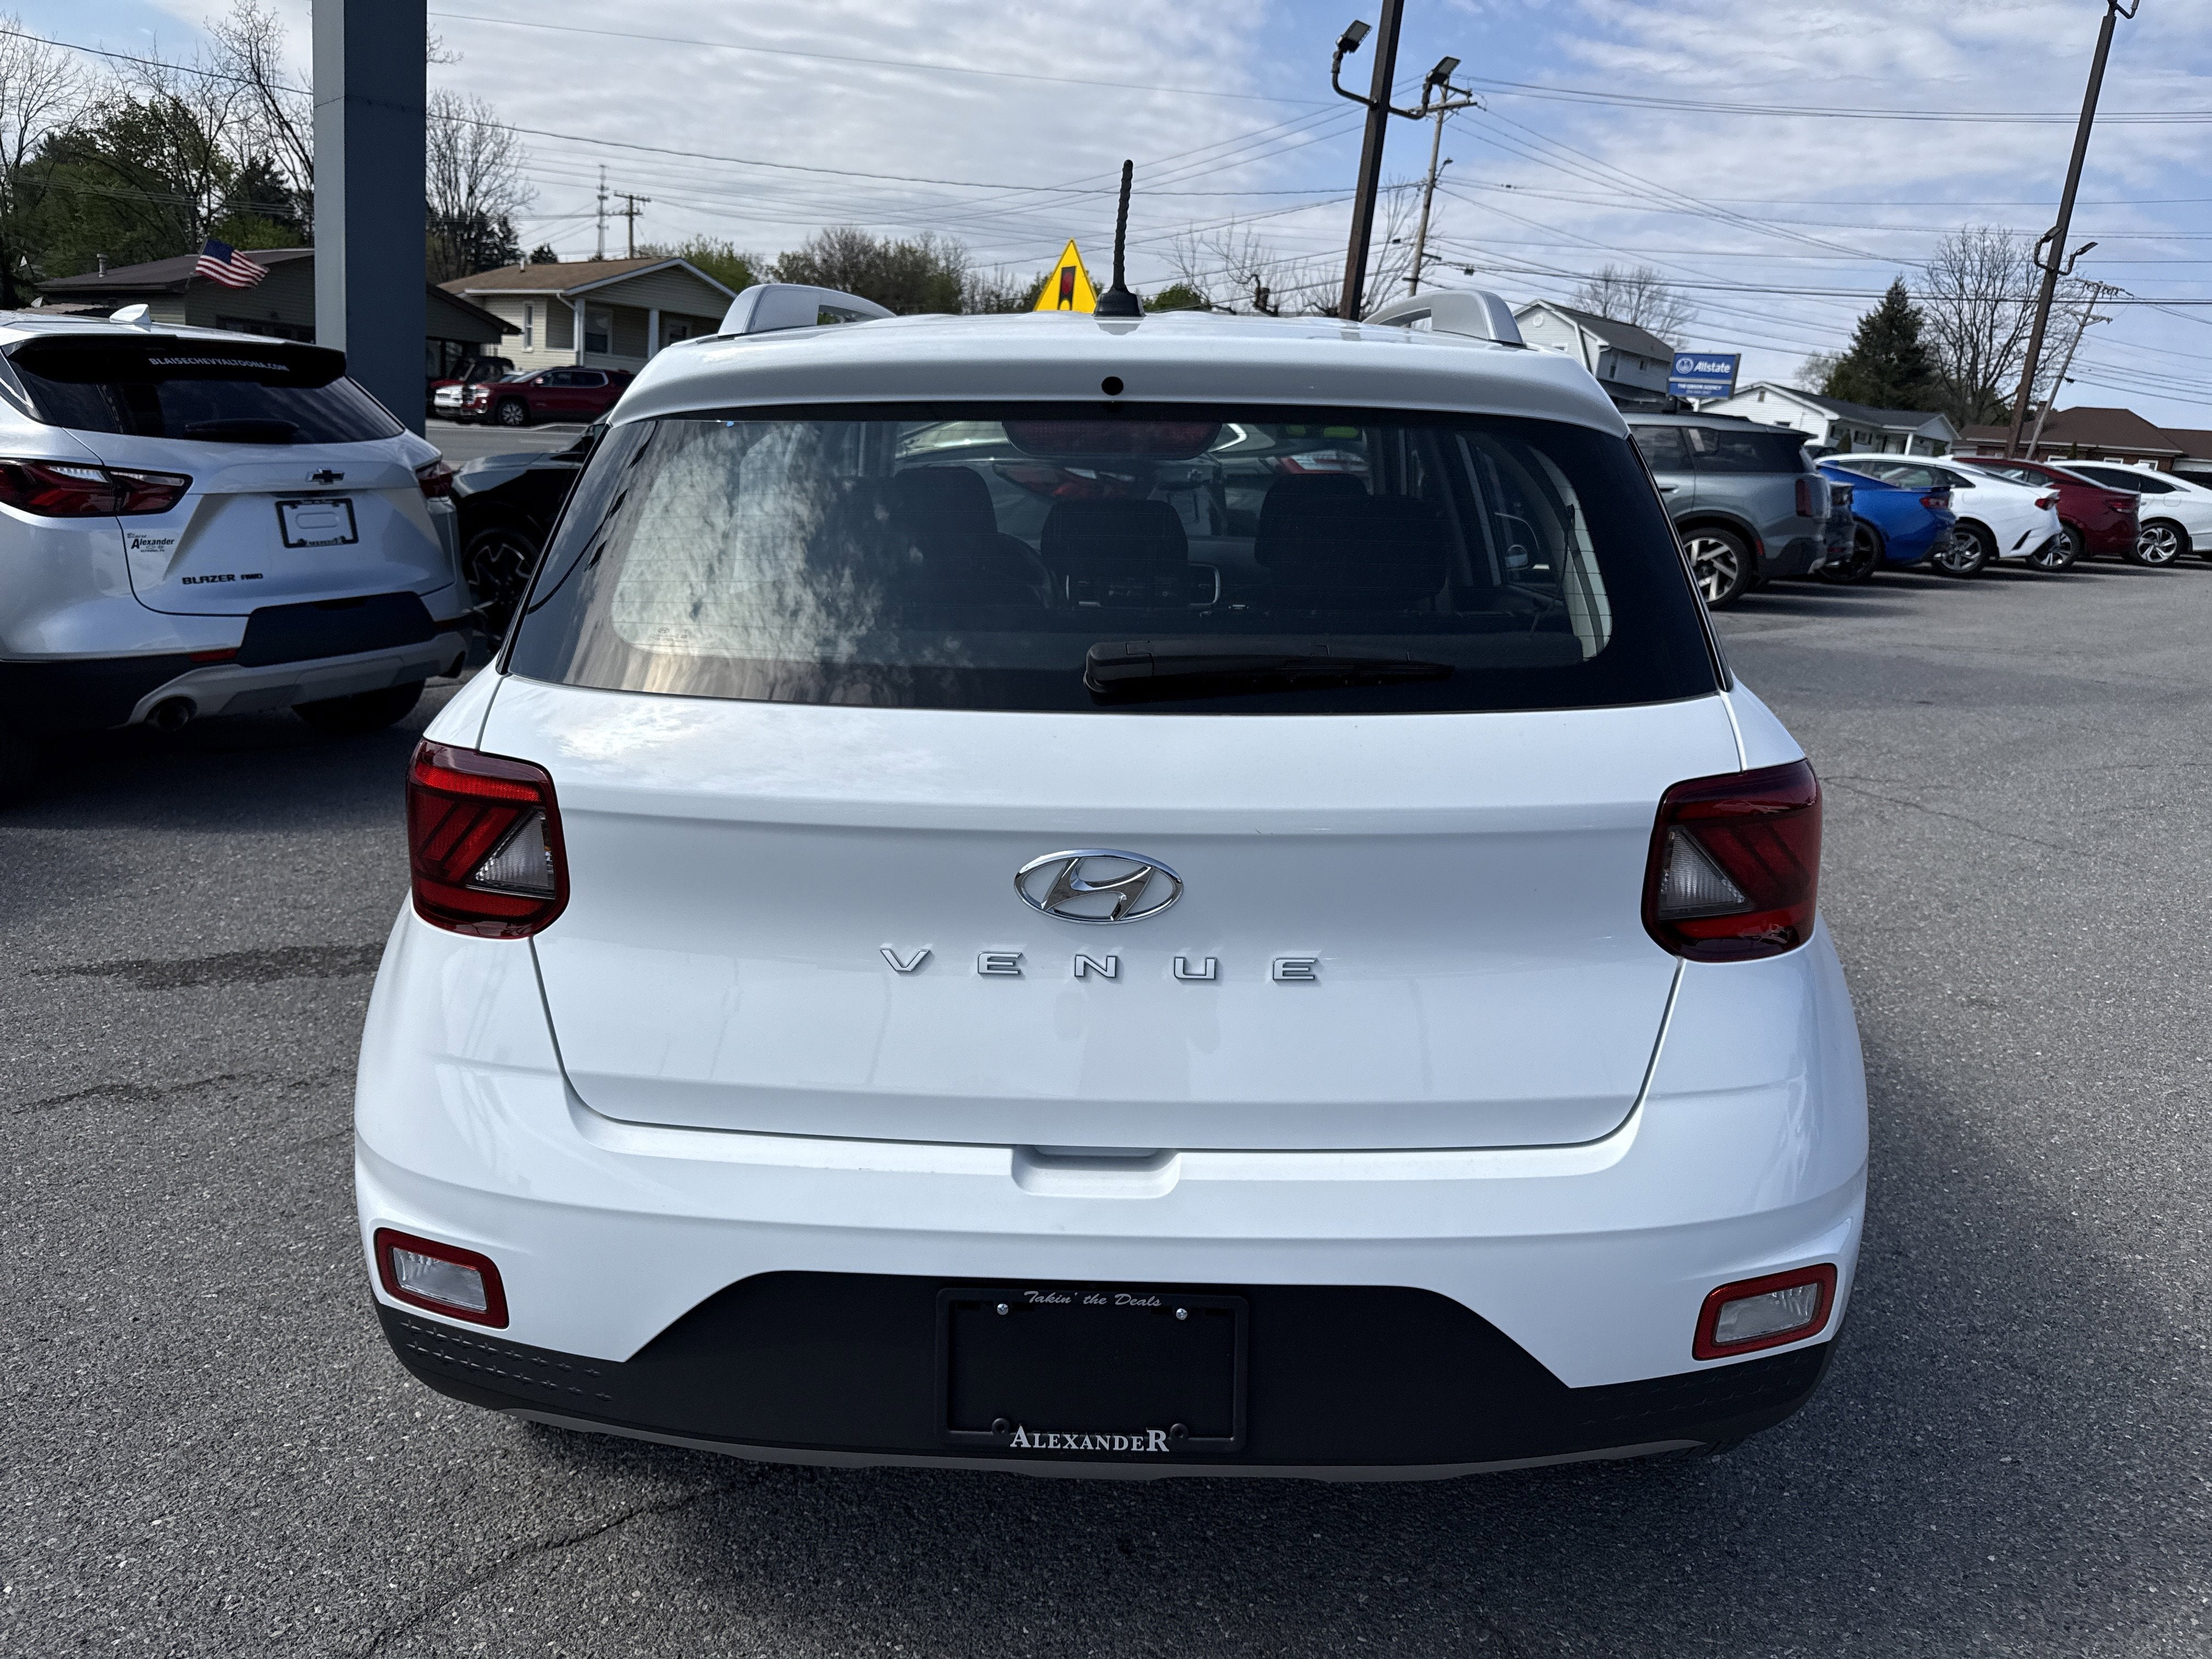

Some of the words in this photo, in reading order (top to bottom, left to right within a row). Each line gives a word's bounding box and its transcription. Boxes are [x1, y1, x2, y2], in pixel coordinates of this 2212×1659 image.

[149, 358, 290, 371] BLAISECHEVYALTOONA.COM
[1693, 360, 1731, 374] Allstate
[131, 538, 174, 550] Alexander
[182, 574, 236, 585] BLAZER
[879, 948, 1318, 981] VENUE
[1024, 1290, 1078, 1304] Takin'
[1082, 1293, 1107, 1305] the
[1114, 1293, 1162, 1307] Deals
[1009, 1425, 1170, 1452] ALEXANDER
